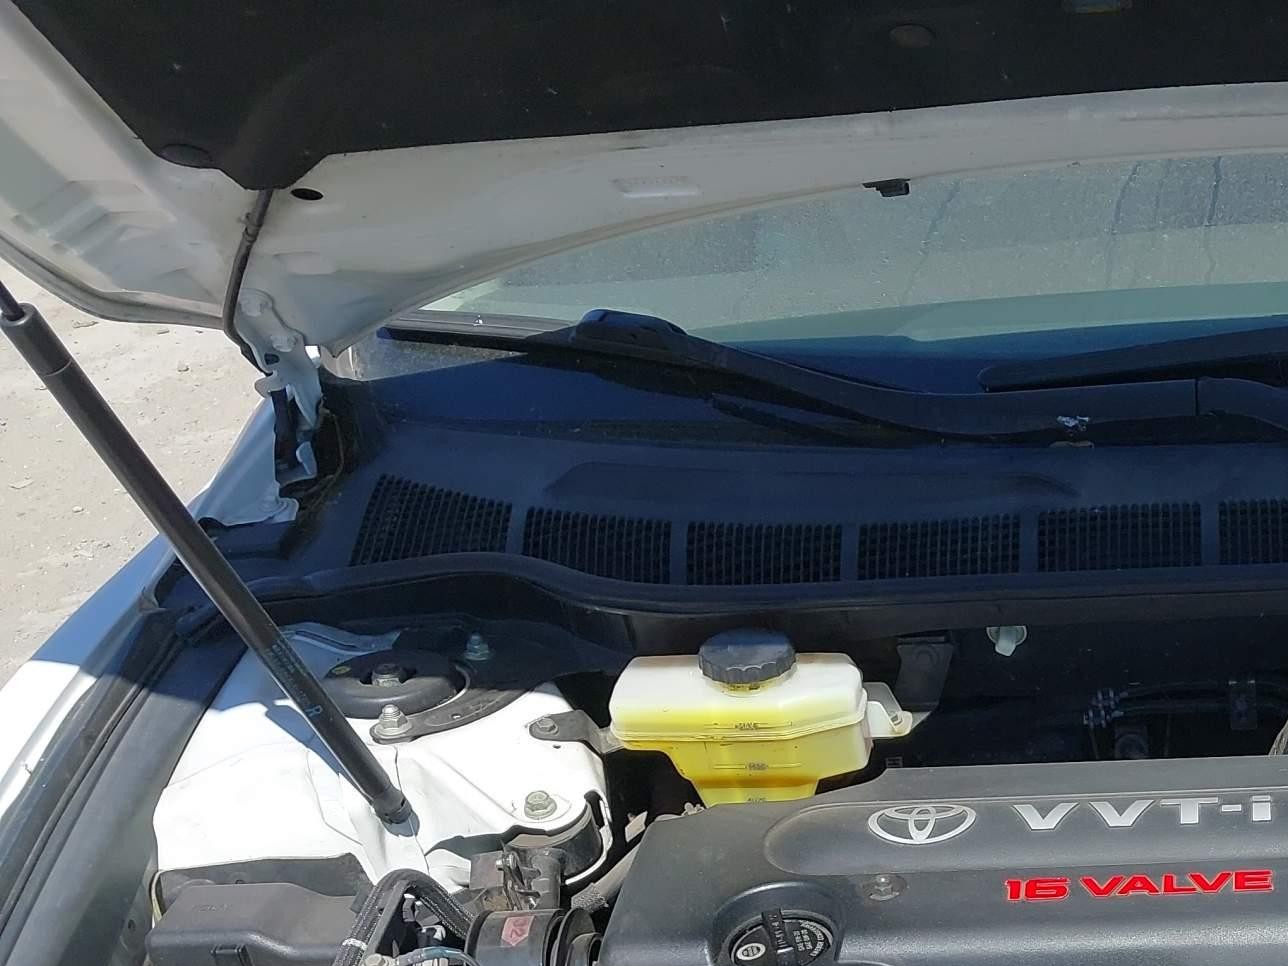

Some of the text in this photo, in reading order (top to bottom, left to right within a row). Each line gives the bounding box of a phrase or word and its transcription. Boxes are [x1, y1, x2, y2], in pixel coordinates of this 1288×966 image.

[1012, 795, 1272, 831] VVT-i
[1005, 869, 1274, 902] 16 VALVE
